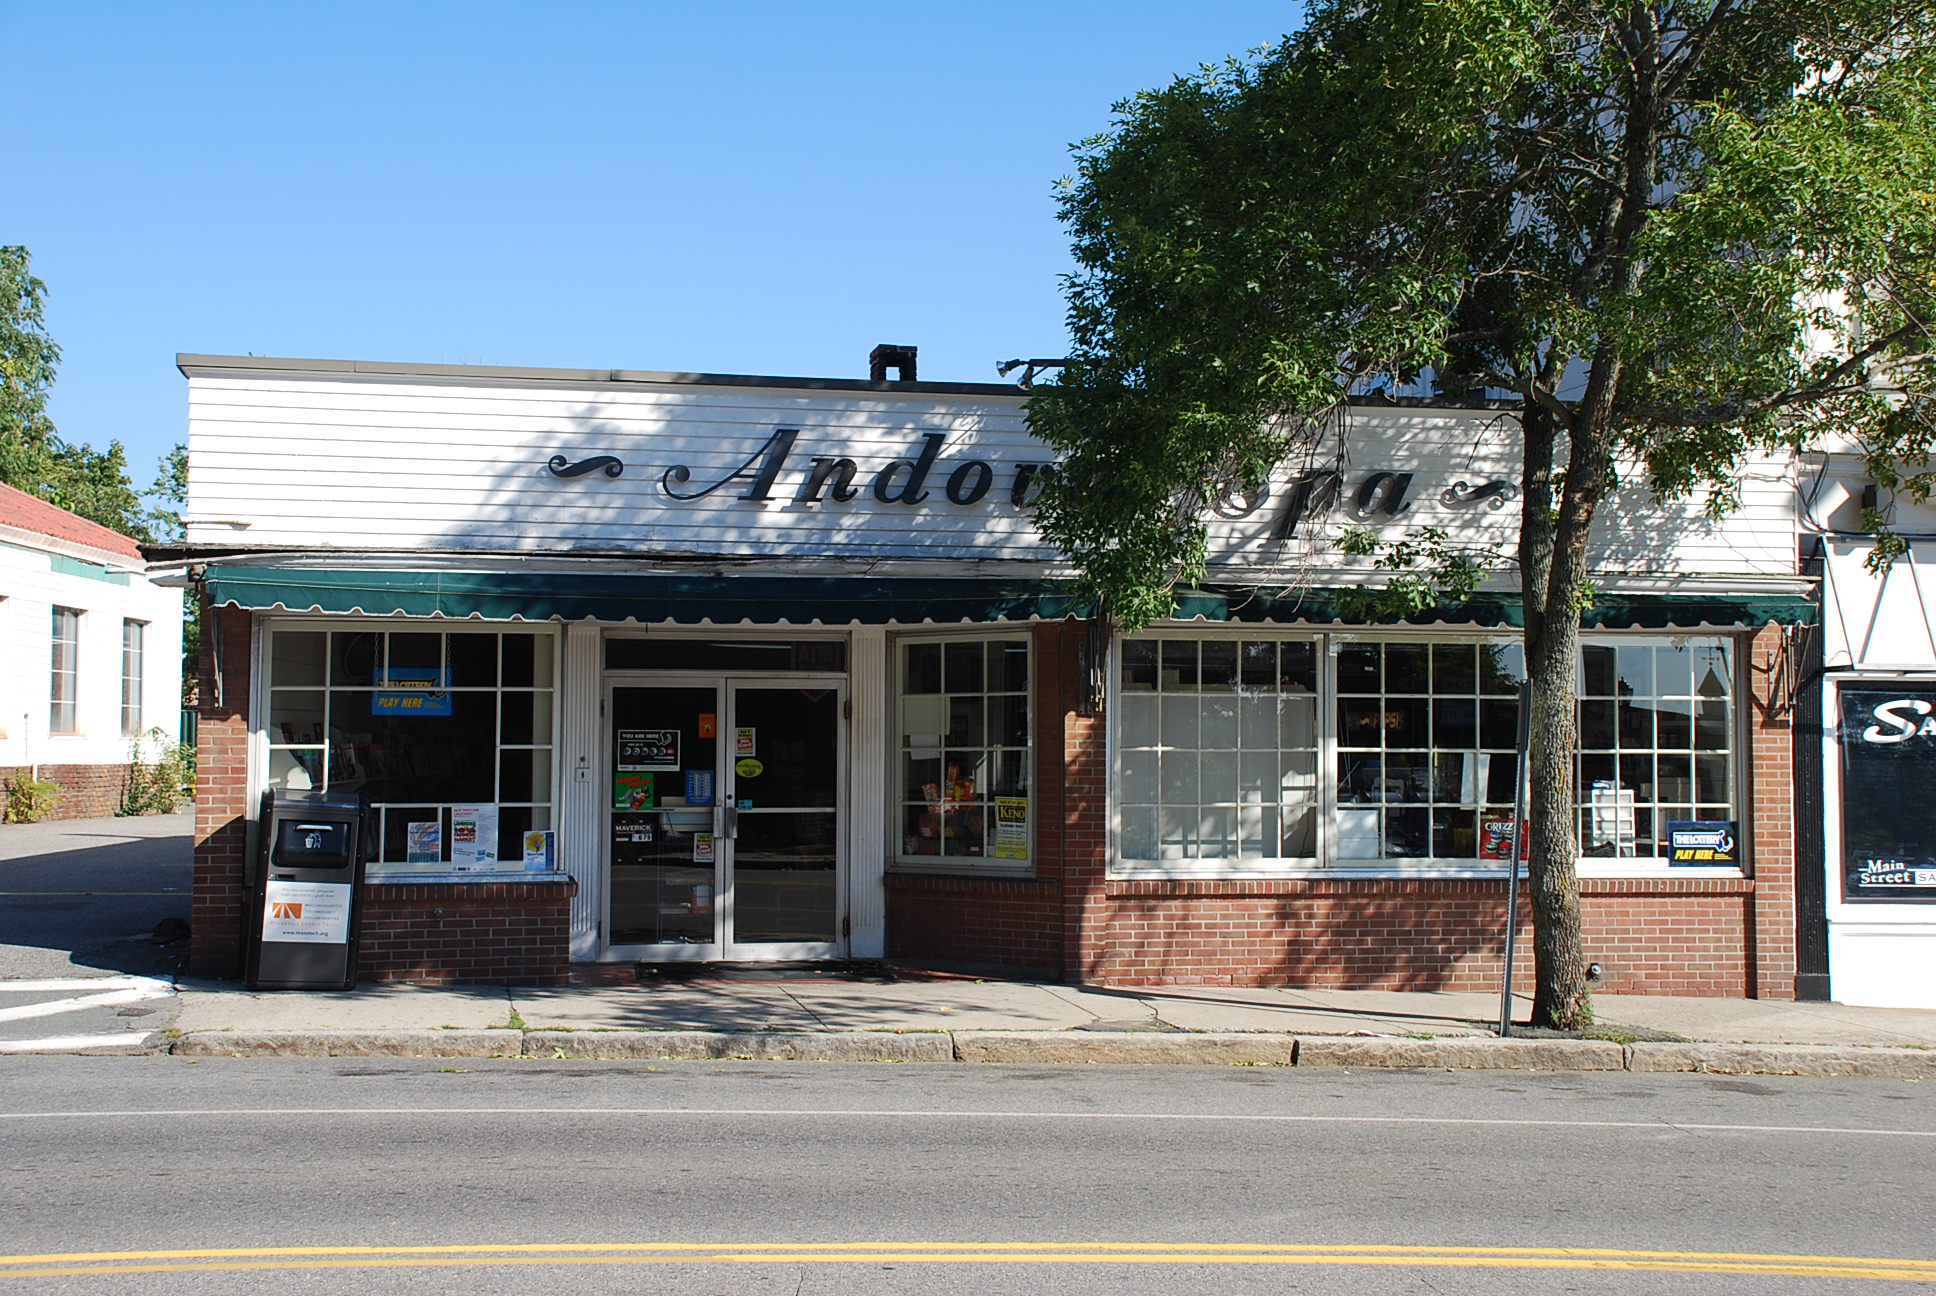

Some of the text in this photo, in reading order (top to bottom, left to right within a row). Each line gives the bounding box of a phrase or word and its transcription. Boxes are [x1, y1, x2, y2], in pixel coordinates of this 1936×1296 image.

[662, 429, 1056, 509] Andov
[378, 697, 399, 708] PLAY
[402, 697, 423, 708] HERE
[1000, 806, 1025, 819] KENO
[1485, 822, 1515, 832] GRIZZ
[1675, 834, 1720, 845] THE LOTTERY
[1675, 849, 1694, 860] PLAY
[1694, 849, 1715, 860] HERE
[1867, 860, 1906, 873] Main
[1860, 871, 1912, 884] Street
